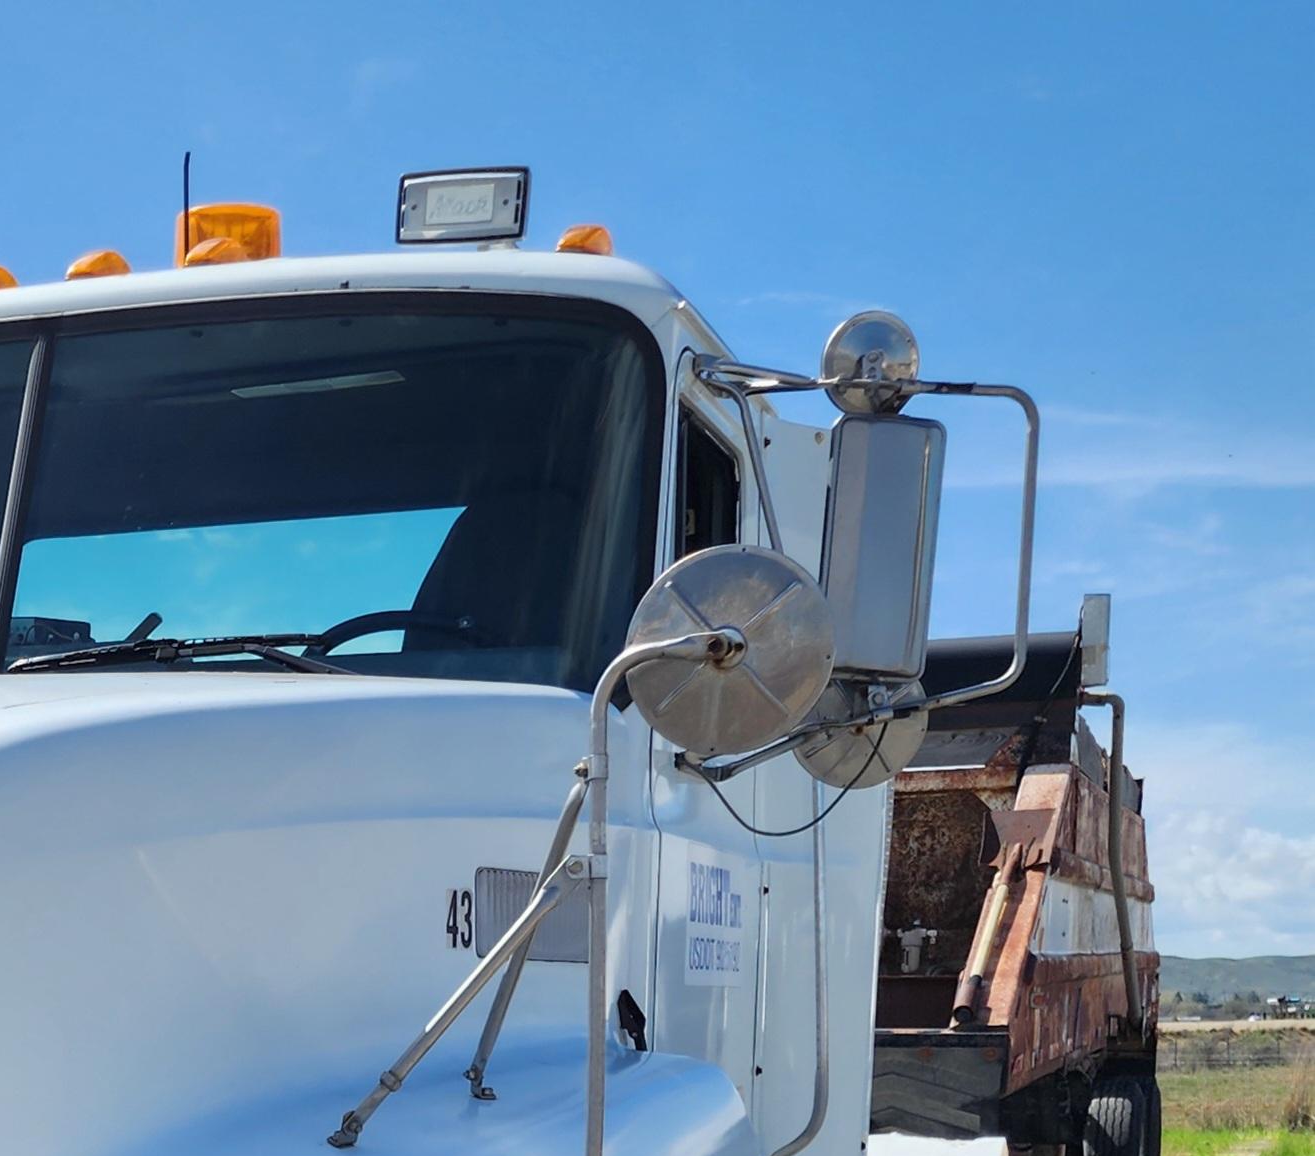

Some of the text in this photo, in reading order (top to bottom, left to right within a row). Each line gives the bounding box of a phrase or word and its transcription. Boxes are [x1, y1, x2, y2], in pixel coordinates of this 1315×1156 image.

[446, 889, 473, 949] 43
[689, 862, 731, 927] BRIGHT
[689, 937, 716, 971] USDOT
